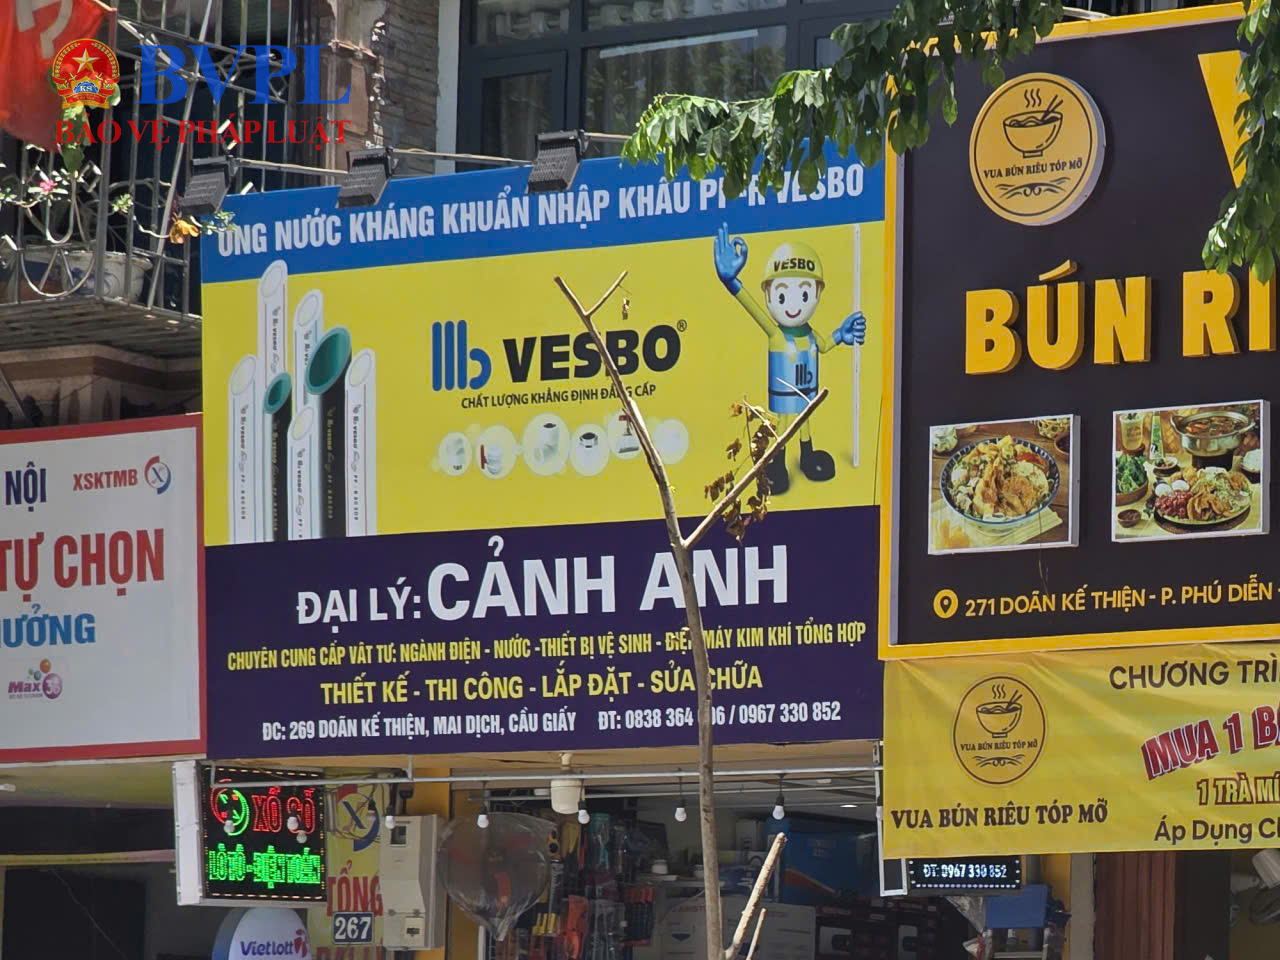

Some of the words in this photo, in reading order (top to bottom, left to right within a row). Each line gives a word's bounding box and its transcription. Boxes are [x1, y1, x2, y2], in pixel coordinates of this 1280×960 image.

[984, 168, 1003, 179] VUA
[1005, 164, 1024, 177] BÚN
[1026, 163, 1048, 175] RIÊU
[1049, 160, 1067, 172] TÓP
[275, 207, 342, 252] NƯỚC
[350, 202, 435, 243] KHÁNG
[443, 185, 529, 234] KHUẨN
[538, 184, 610, 230] NHẬP
[772, 257, 817, 273] VESBO
[965, 259, 1152, 375] BÚN
[571, 387, 598, 404] ĐỊNH
[5, 461, 47, 513] NỘI
[72, 468, 138, 492] XSKTMB
[53, 528, 165, 596] CHỌN
[296, 588, 358, 634] ĐẠI
[369, 576, 421, 621] LÝ:
[427, 535, 618, 622] CẢNH
[640, 543, 789, 611] ANH
[964, 598, 997, 617] 271
[1000, 590, 1056, 616] DOÃN
[1061, 583, 1089, 612] KẾ
[1091, 584, 1146, 613] THIỆN
[1160, 588, 1177, 606] P.
[1181, 580, 1222, 605] PHÚ
[1227, 573, 1273, 603] DIỄN
[0, 602, 96, 649] ƯỞNG
[227, 646, 278, 671] CHUYÊN
[281, 648, 317, 668] CUNG
[319, 640, 346, 666] CẤP
[399, 639, 446, 664] NGÀNH
[449, 637, 481, 664] ĐIỆN
[493, 633, 531, 660] NƯỚC
[580, 636, 595, 660] BỊ
[598, 631, 615, 659] VỆ
[618, 633, 652, 655] SINH
[703, 625, 733, 649] MÁY
[736, 627, 764, 648] KIM
[768, 621, 792, 647] KHÍ
[795, 616, 833, 645] TỔNG
[837, 622, 867, 647] HỢP
[320, 671, 377, 705] THIẾT
[383, 670, 411, 703] KẾ
[425, 678, 458, 702] THI
[463, 671, 524, 701] CÔNG
[542, 660, 582, 698] LẮP
[587, 665, 632, 703] ĐẶT
[650, 659, 696, 694] SỬA
[708, 660, 763, 691] CHỮA
[1109, 658, 1229, 690] CHƯƠNG
[262, 722, 287, 742] ĐC:
[289, 720, 316, 741] 269
[318, 716, 358, 739] DOÃN
[361, 711, 382, 738] KẾ
[383, 712, 430, 741] THIỆN,
[433, 716, 462, 736] MAI
[465, 714, 505, 739] DỊCH,
[508, 706, 539, 734] CẦU
[542, 705, 576, 732] GIẤY
[598, 710, 622, 731] ĐT:
[625, 708, 662, 729] 0838
[665, 707, 694, 728] 364
[738, 703, 776, 725] 0967
[779, 702, 808, 722] 330
[812, 700, 842, 722] 852
[960, 743, 978, 752] VUA
[977, 740, 993, 752] BÚN
[994, 739, 1012, 751] RIÊU
[1012, 740, 1026, 750] TÓP
[1140, 718, 1220, 781] MUA
[1222, 711, 1244, 755] 1
[1213, 770, 1255, 806] TRÀ
[891, 809, 935, 830] VUA
[938, 802, 979, 828] BÚN
[984, 801, 1031, 827] RIÊU
[1035, 799, 1074, 825] TÓP
[1078, 798, 1109, 824] MỠ
[1153, 814, 1187, 846] Áp
[1192, 818, 1253, 846] Dụng
[941, 863, 966, 879] 0967
[968, 863, 988, 879] 330
[989, 864, 1008, 878] 852
[334, 917, 372, 940] 267
[240, 940, 294, 956] Vietlott
